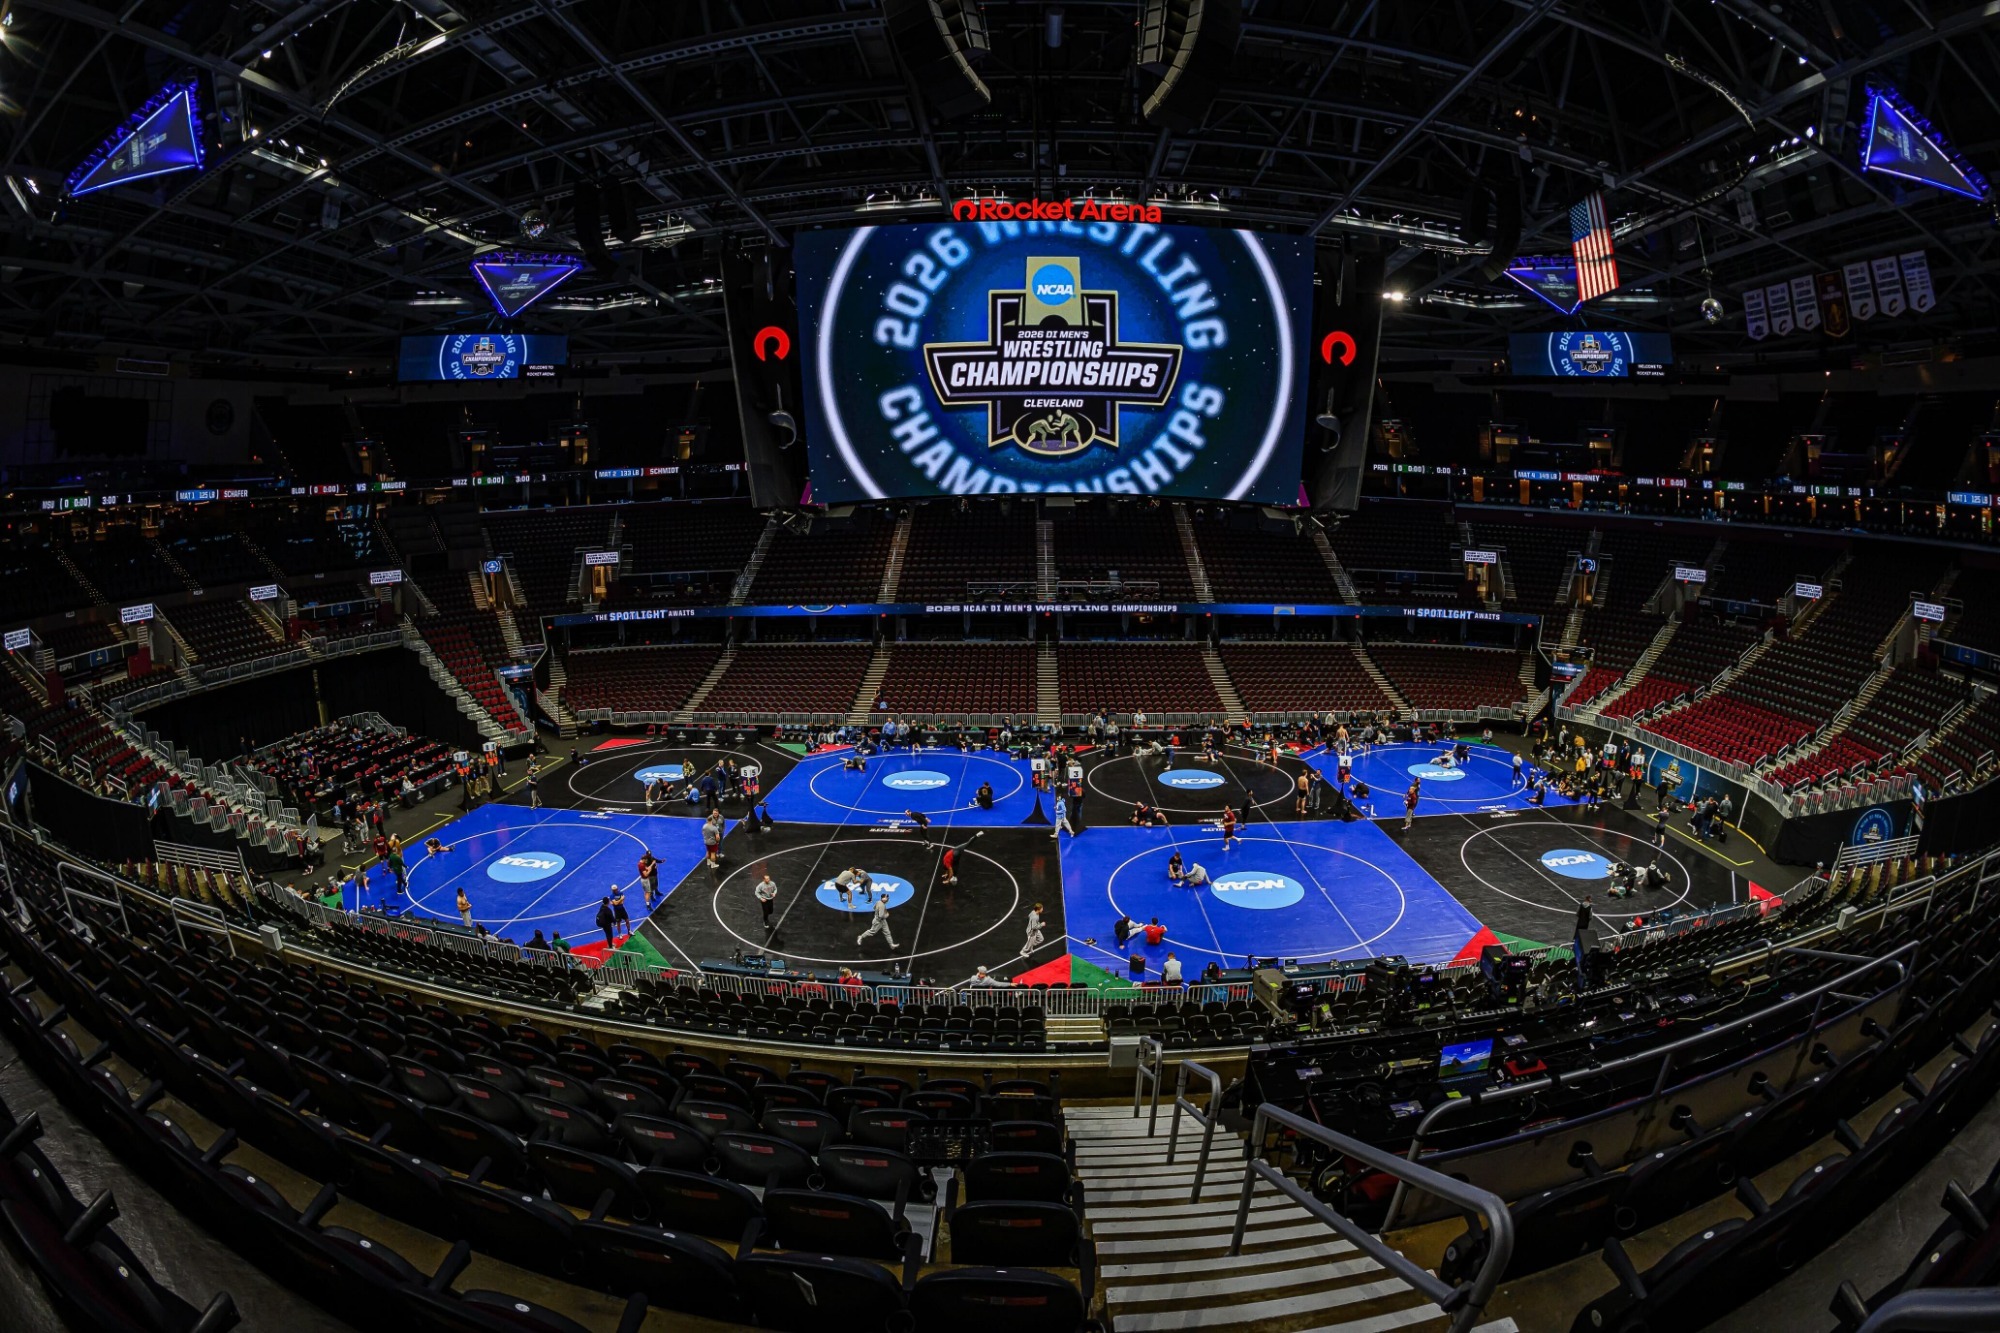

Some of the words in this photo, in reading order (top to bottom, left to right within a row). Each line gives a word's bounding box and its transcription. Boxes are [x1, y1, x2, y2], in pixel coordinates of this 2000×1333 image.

[980, 198, 1074, 220] Rocket
[1080, 199, 1162, 223] Arena
[875, 228, 970, 347] 2026
[1036, 284, 1074, 296] NCAA
[1018, 330, 1044, 338] 2026
[1046, 330, 1058, 338] DI
[1059, 330, 1089, 339] MEN'S
[452, 335, 470, 354] 202
[1560, 332, 1574, 350] 202
[1003, 340, 1103, 358] WRESTLING
[950, 360, 1159, 388] CHAMPIONSHIPS
[1024, 399, 1084, 408] CLEVELAND
[224, 490, 248, 498] SCHAFER
[609, 609, 666, 621] SPOTLIGHT
[1417, 608, 1472, 620] SPOTLIGHT
[1420, 769, 1465, 778] NCAA
[498, 856, 558, 869] NCAA
[1544, 854, 1596, 867] NCAA
[1212, 879, 1286, 891] NCAA
